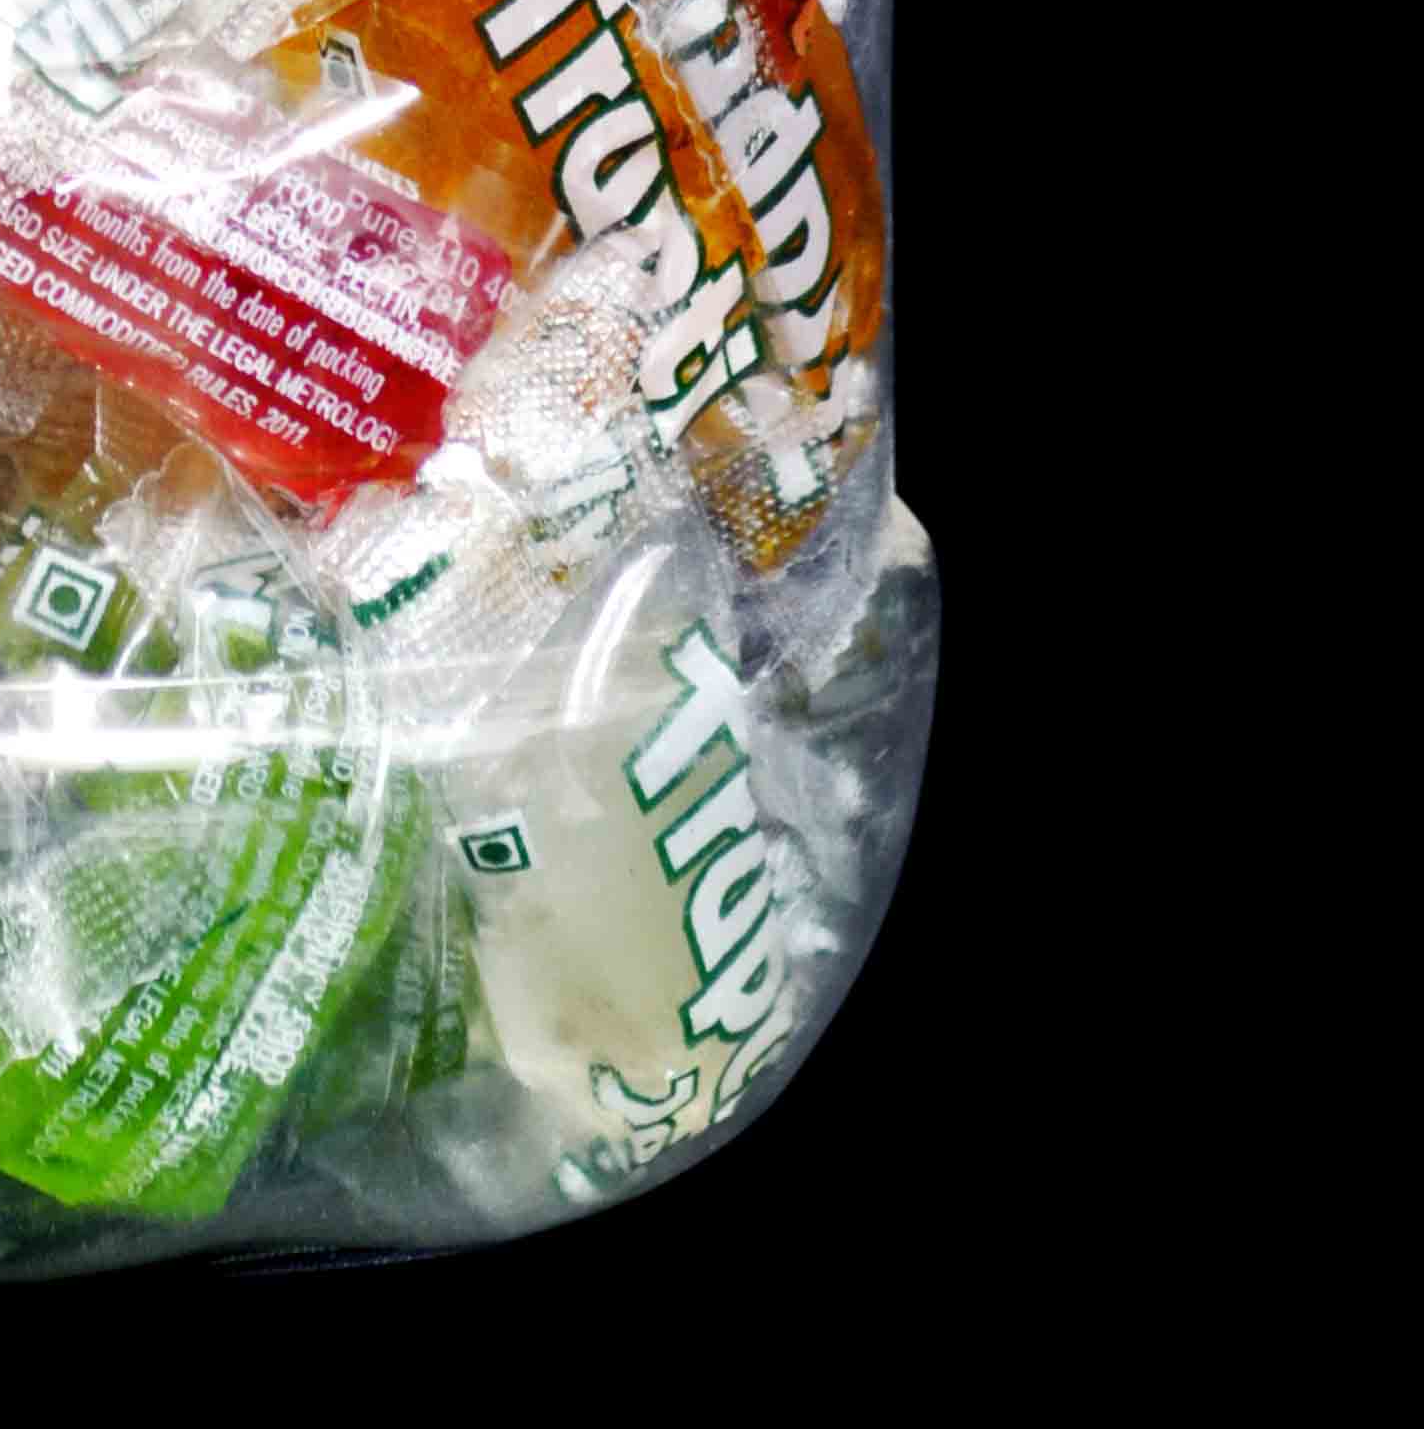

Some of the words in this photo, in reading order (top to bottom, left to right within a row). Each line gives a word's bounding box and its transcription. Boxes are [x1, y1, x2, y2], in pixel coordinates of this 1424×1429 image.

[70, 189, 158, 259] months
[146, 231, 212, 291] from
[196, 262, 246, 313] the
[35, 221, 98, 276] SIZE
[85, 253, 174, 322] UNDER
[164, 300, 217, 349] THE
[205, 325, 284, 388] LEGAL
[271, 364, 405, 459] METROLOGY
[233, 284, 293, 341] date
[282, 312, 319, 355] of
[300, 325, 395, 408] packing
[621, 614, 794, 1126] Trup
